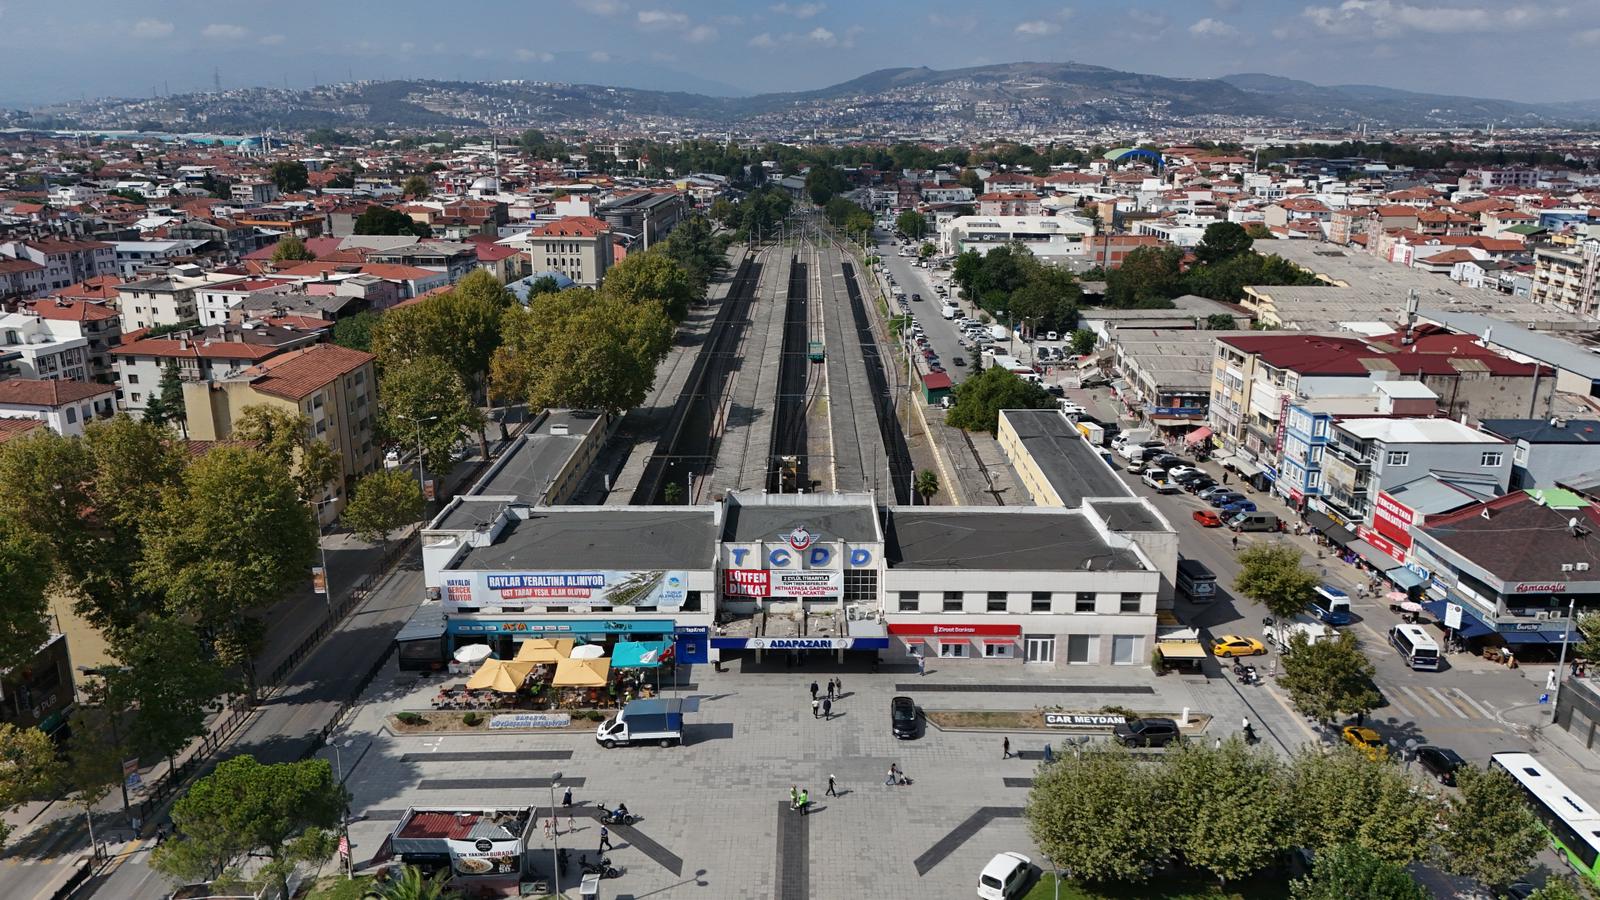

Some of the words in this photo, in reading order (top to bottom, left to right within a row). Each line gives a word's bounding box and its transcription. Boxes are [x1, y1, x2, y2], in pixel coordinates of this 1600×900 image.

[732, 548, 872, 567] TCDD
[489, 577, 520, 587] RAYLAR
[523, 576, 565, 587] YERALTINA
[567, 575, 604, 586] ALINIYOR
[730, 570, 767, 583] LÜTFEN
[515, 588, 533, 596] TARAF
[551, 588, 566, 596] ALAN
[568, 588, 590, 596] OLUYOR
[729, 583, 767, 596] DİKKAT
[448, 593, 472, 601] OLUYOR
[770, 640, 832, 648] ADAPAZARI
[1047, 715, 1072, 723] GAR
[1075, 716, 1126, 724] MEYDANI
